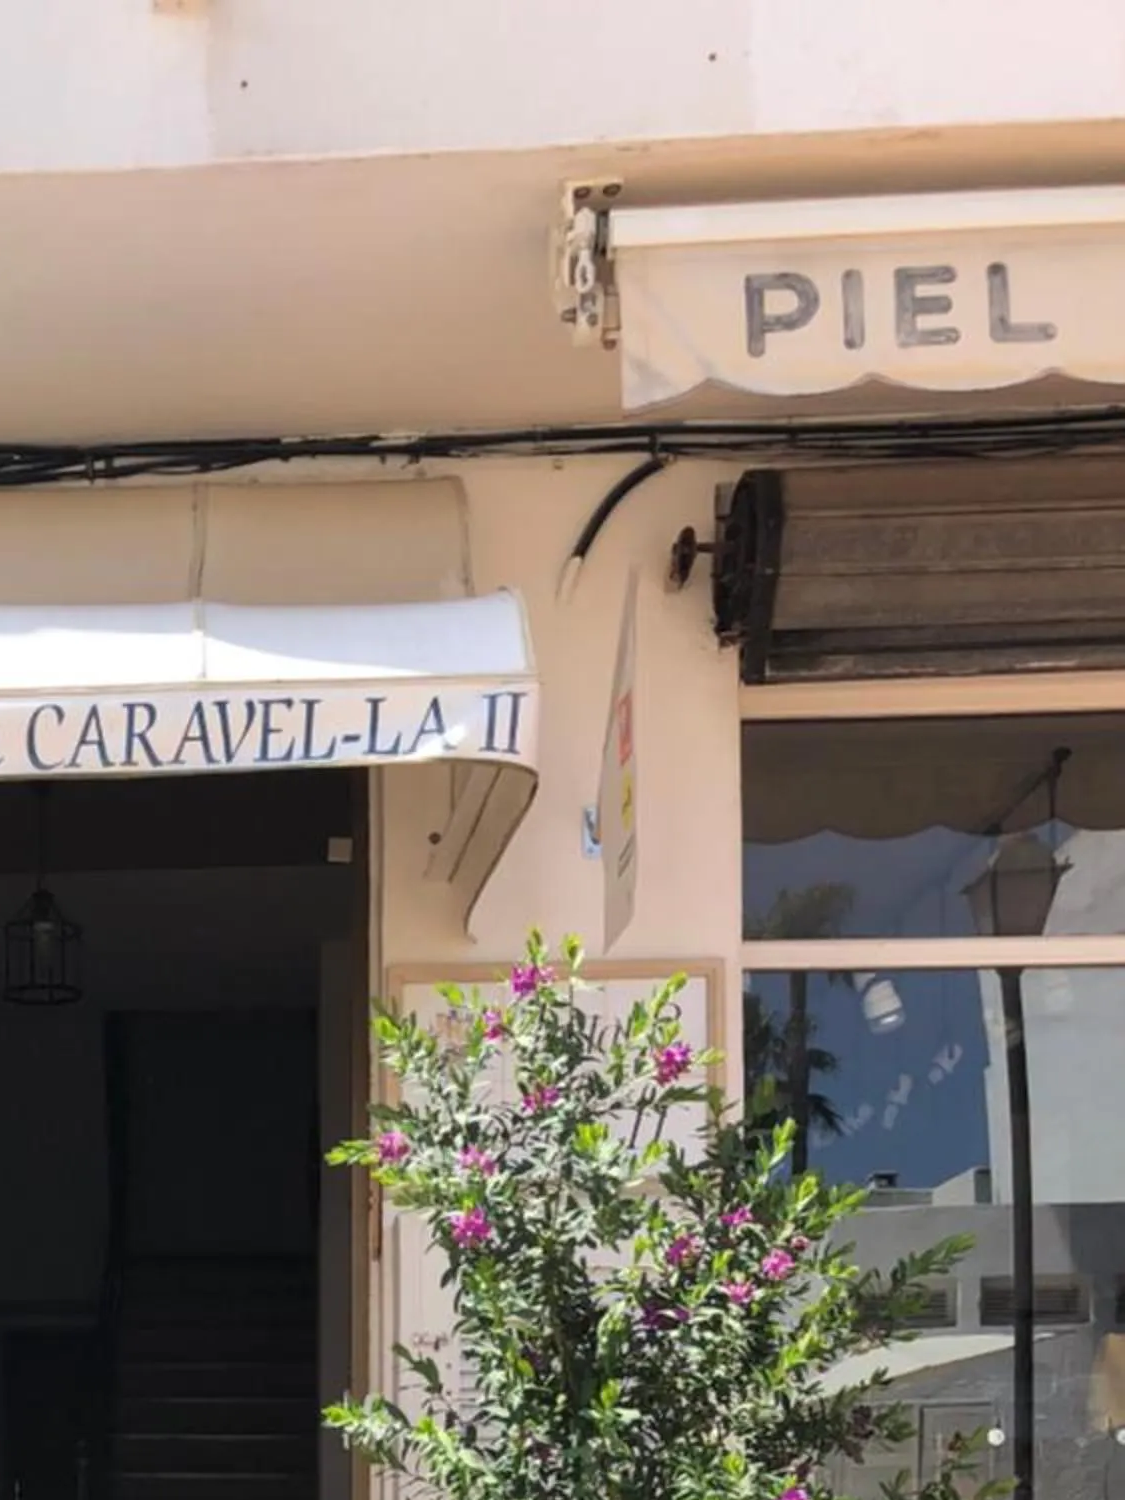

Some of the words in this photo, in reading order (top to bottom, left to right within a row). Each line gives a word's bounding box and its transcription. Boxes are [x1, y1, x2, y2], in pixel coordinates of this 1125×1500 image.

[744, 261, 1057, 358] PIEL
[25, 694, 465, 771] CARAVEL-LA
[482, 690, 529, 754] II
